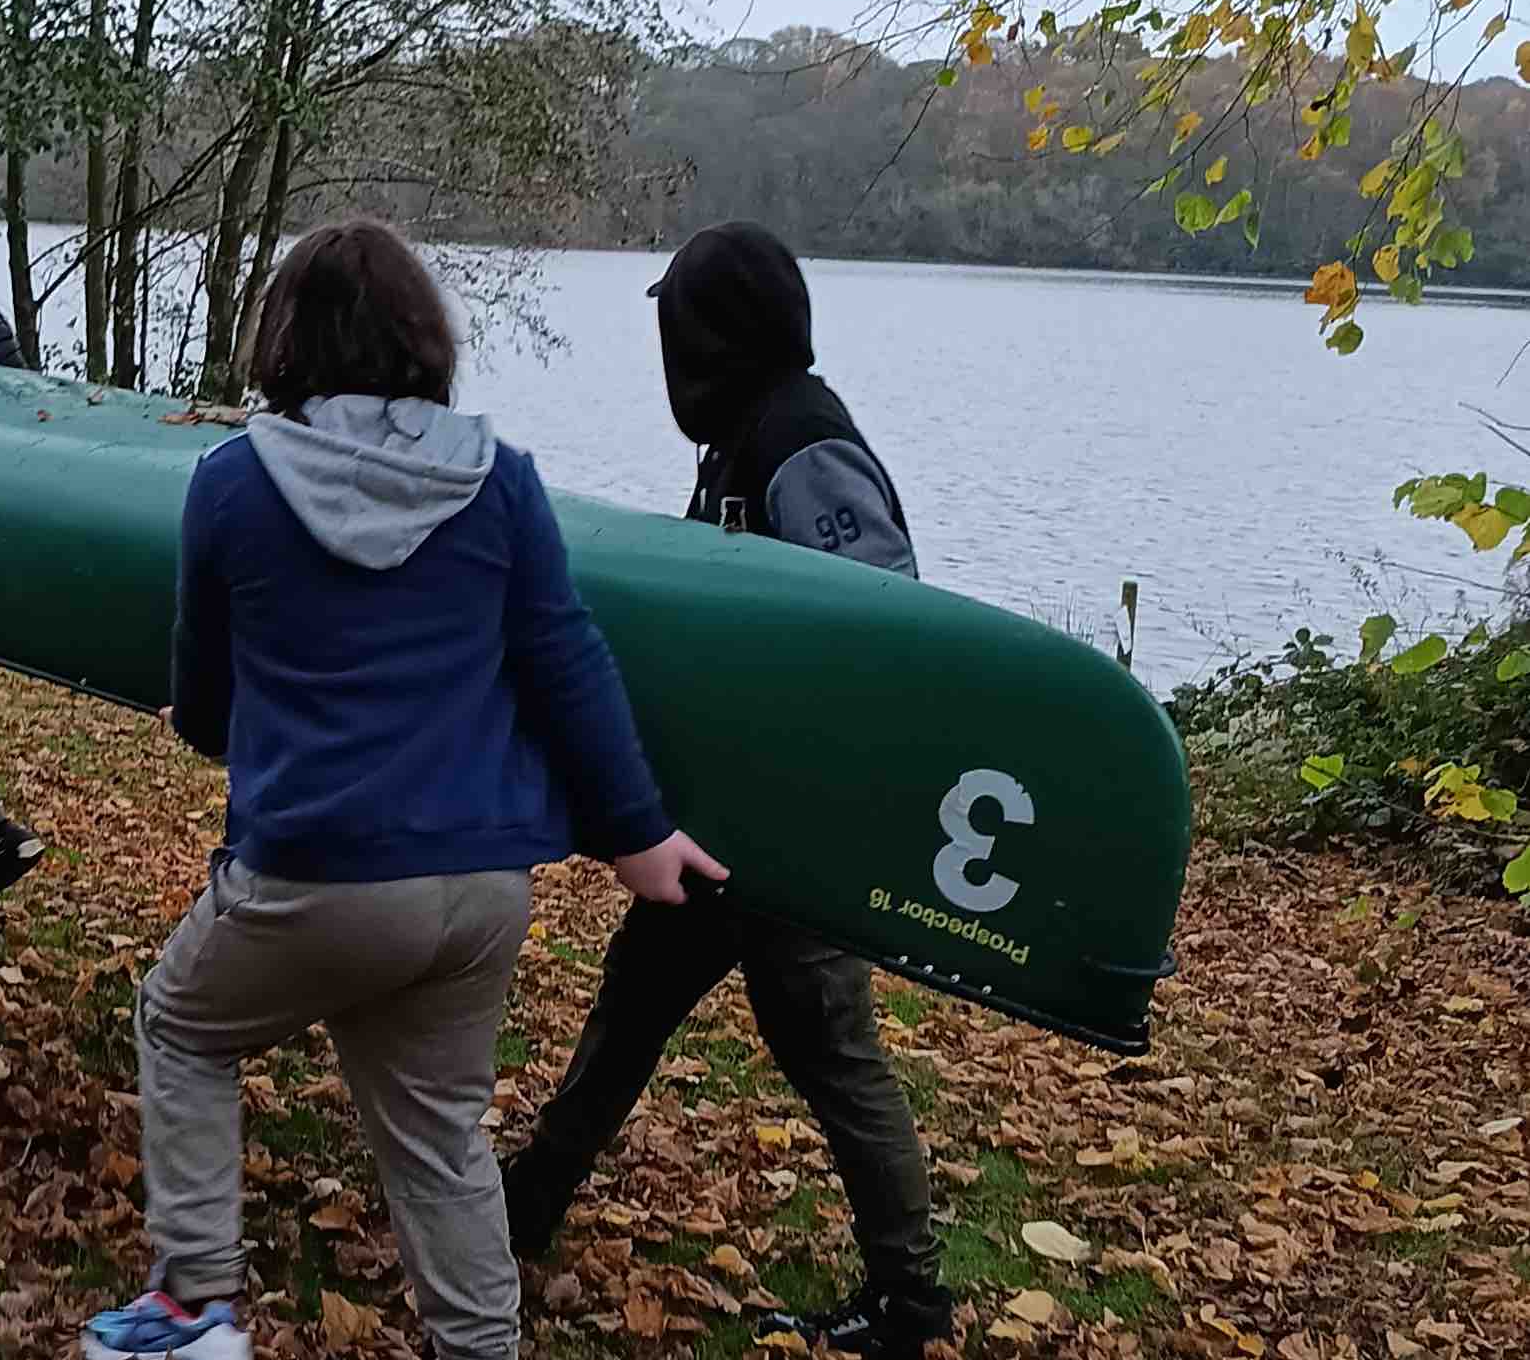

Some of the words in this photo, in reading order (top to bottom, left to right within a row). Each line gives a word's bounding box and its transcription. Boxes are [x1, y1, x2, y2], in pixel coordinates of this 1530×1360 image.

[815, 506, 862, 551] 99
[933, 768, 1035, 913] 3
[869, 887, 892, 912] 16
[897, 897, 1030, 965] Prospector
